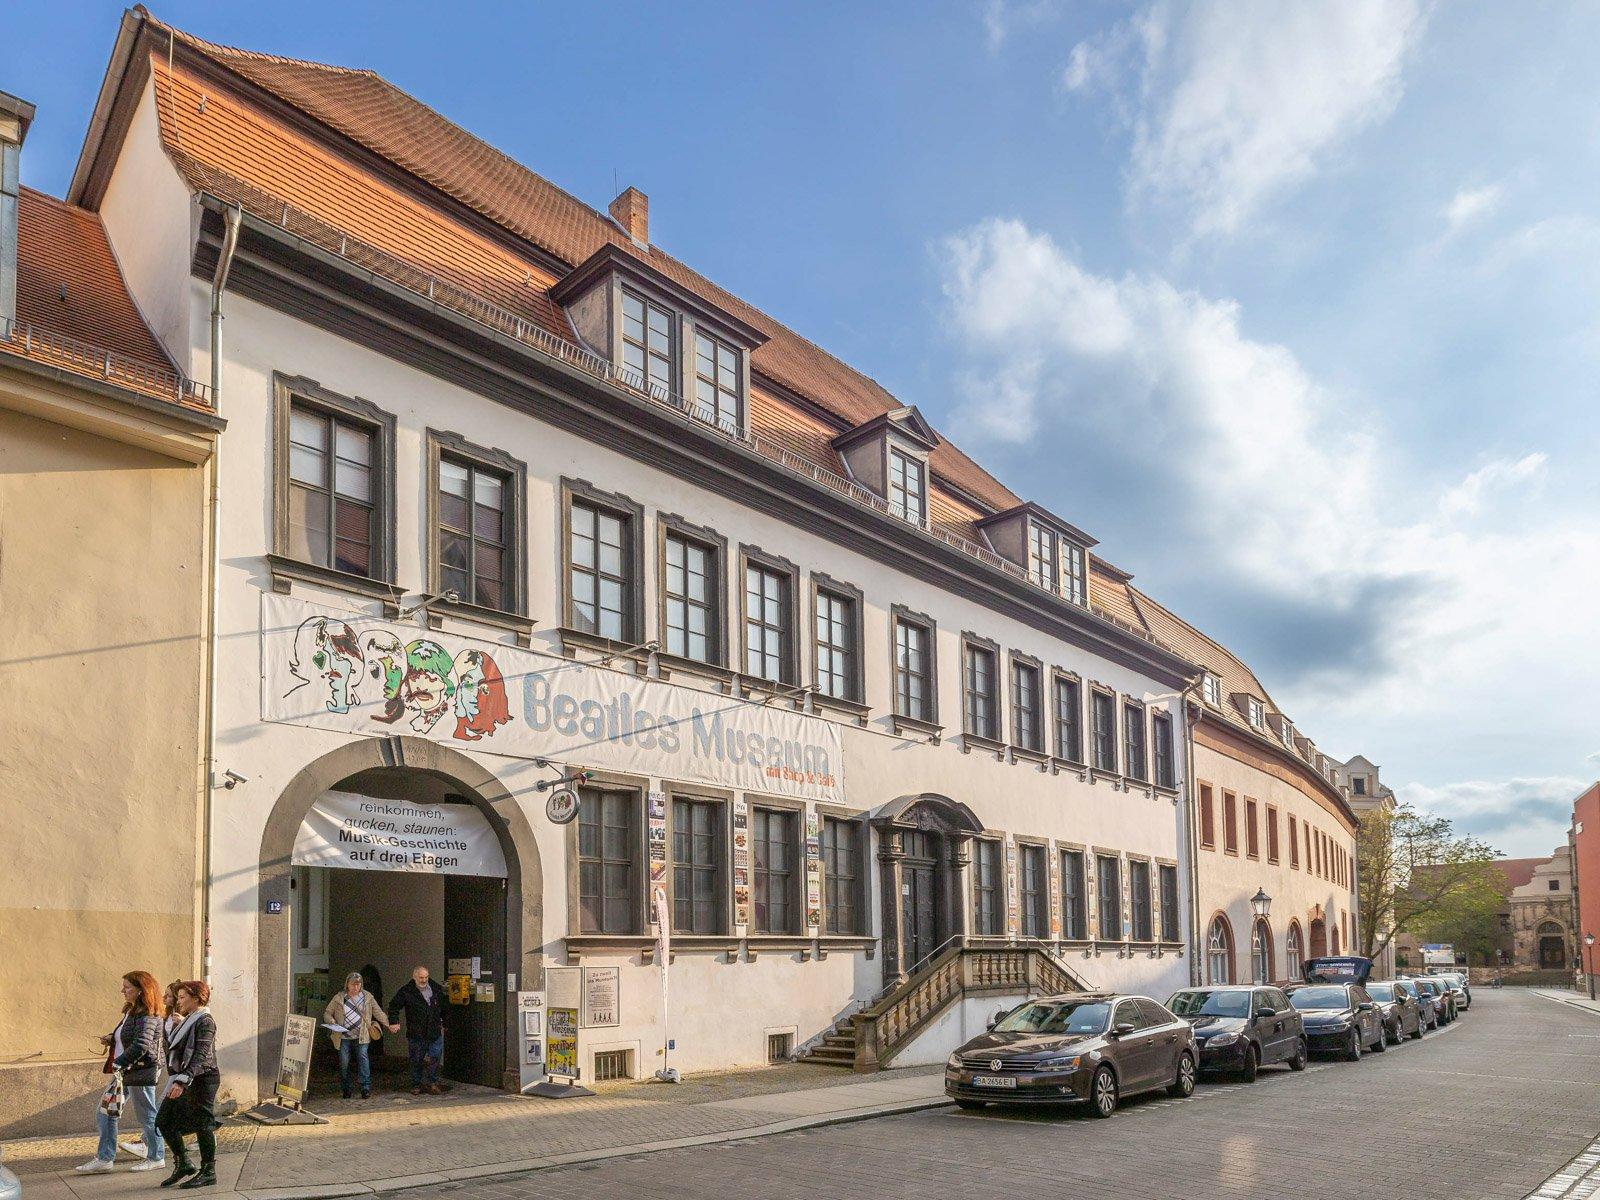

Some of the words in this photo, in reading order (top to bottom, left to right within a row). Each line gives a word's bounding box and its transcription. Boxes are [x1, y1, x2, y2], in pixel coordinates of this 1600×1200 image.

[523, 672, 680, 754] Beatles
[692, 707, 829, 776] Museum
[807, 770, 815, 784] &
[360, 802, 445, 820] reinkommen,
[344, 817, 398, 834] gucken,
[403, 822, 457, 836] staunen:
[339, 829, 467, 851] Musik-Geschichte
[349, 849, 375, 861] auf
[380, 850, 408, 863] drei
[412, 852, 458, 869] Etagen
[270, 902, 281, 911] 12
[977, 1076, 986, 1085] BA
